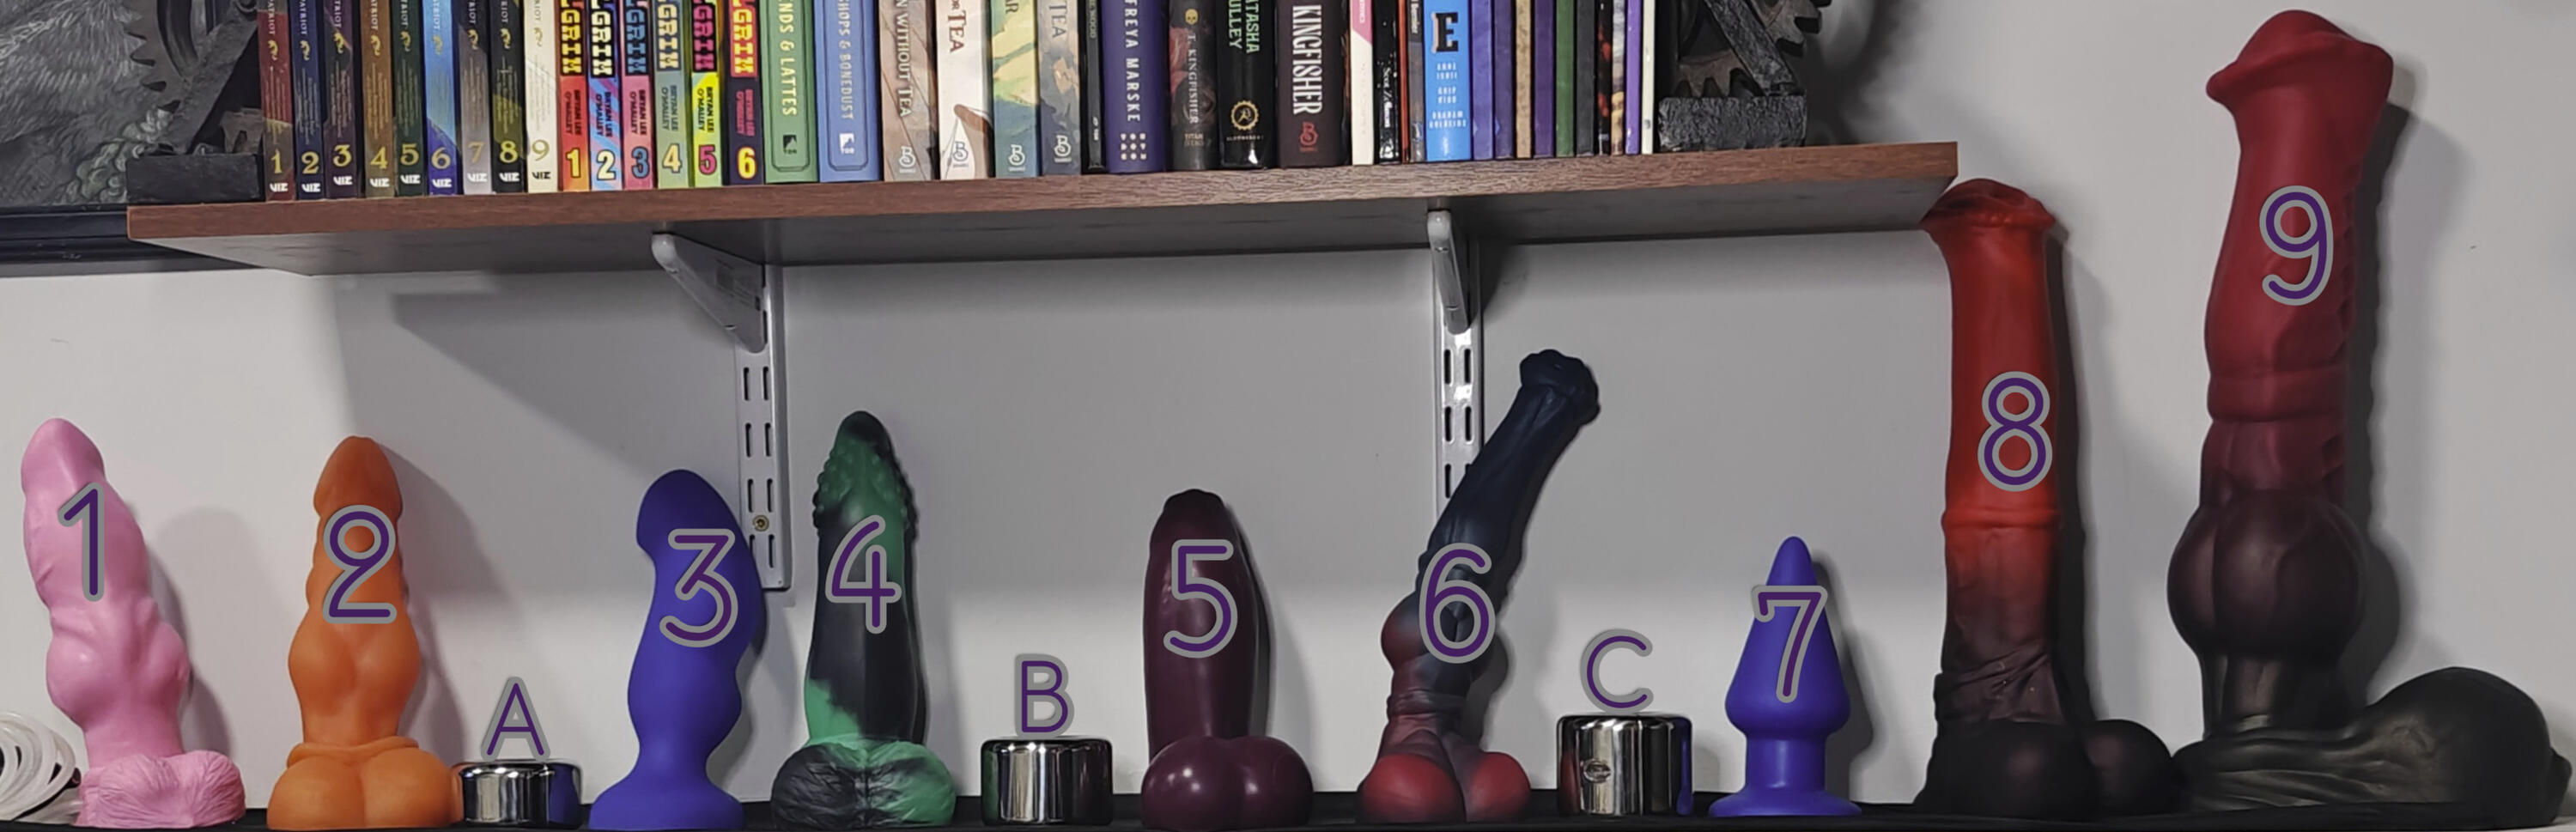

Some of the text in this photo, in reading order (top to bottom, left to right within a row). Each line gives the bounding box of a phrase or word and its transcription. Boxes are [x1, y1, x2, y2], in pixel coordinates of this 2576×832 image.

[779, 0, 793, 33] NDS
[837, 0, 850, 36] HOPS
[1125, 0, 1139, 48] FREYA
[1432, 12, 1459, 53] E
[896, 13, 911, 82] WITHOUT
[1292, 4, 1323, 114] KINGFISHER
[780, 58, 798, 117] LATTES
[839, 52, 854, 120] BONEDUST
[1125, 58, 1141, 122] MARSKE
[1188, 49, 1199, 124] KINGFISHER
[270, 149, 283, 174] 1
[301, 151, 319, 174] 2
[333, 144, 352, 167] 3
[370, 146, 388, 169] 4
[400, 143, 419, 166] 5
[431, 147, 451, 169] 6
[468, 141, 484, 164] 7
[500, 140, 518, 163] 8
[532, 139, 550, 161] 9
[631, 146, 650, 179] 3
[662, 143, 683, 173] 4
[698, 144, 717, 174] 5
[566, 148, 581, 179] 1
[596, 149, 617, 180] 2
[738, 147, 756, 179] 6
[270, 183, 289, 192] VIZ
[301, 183, 321, 192] VIZ
[333, 175, 353, 185] VIZ
[370, 178, 390, 187] VIZ
[400, 174, 421, 184] VIZ
[432, 178, 452, 188] VIZ
[467, 173, 488, 182] VIZ
[499, 172, 519, 182] VIZ
